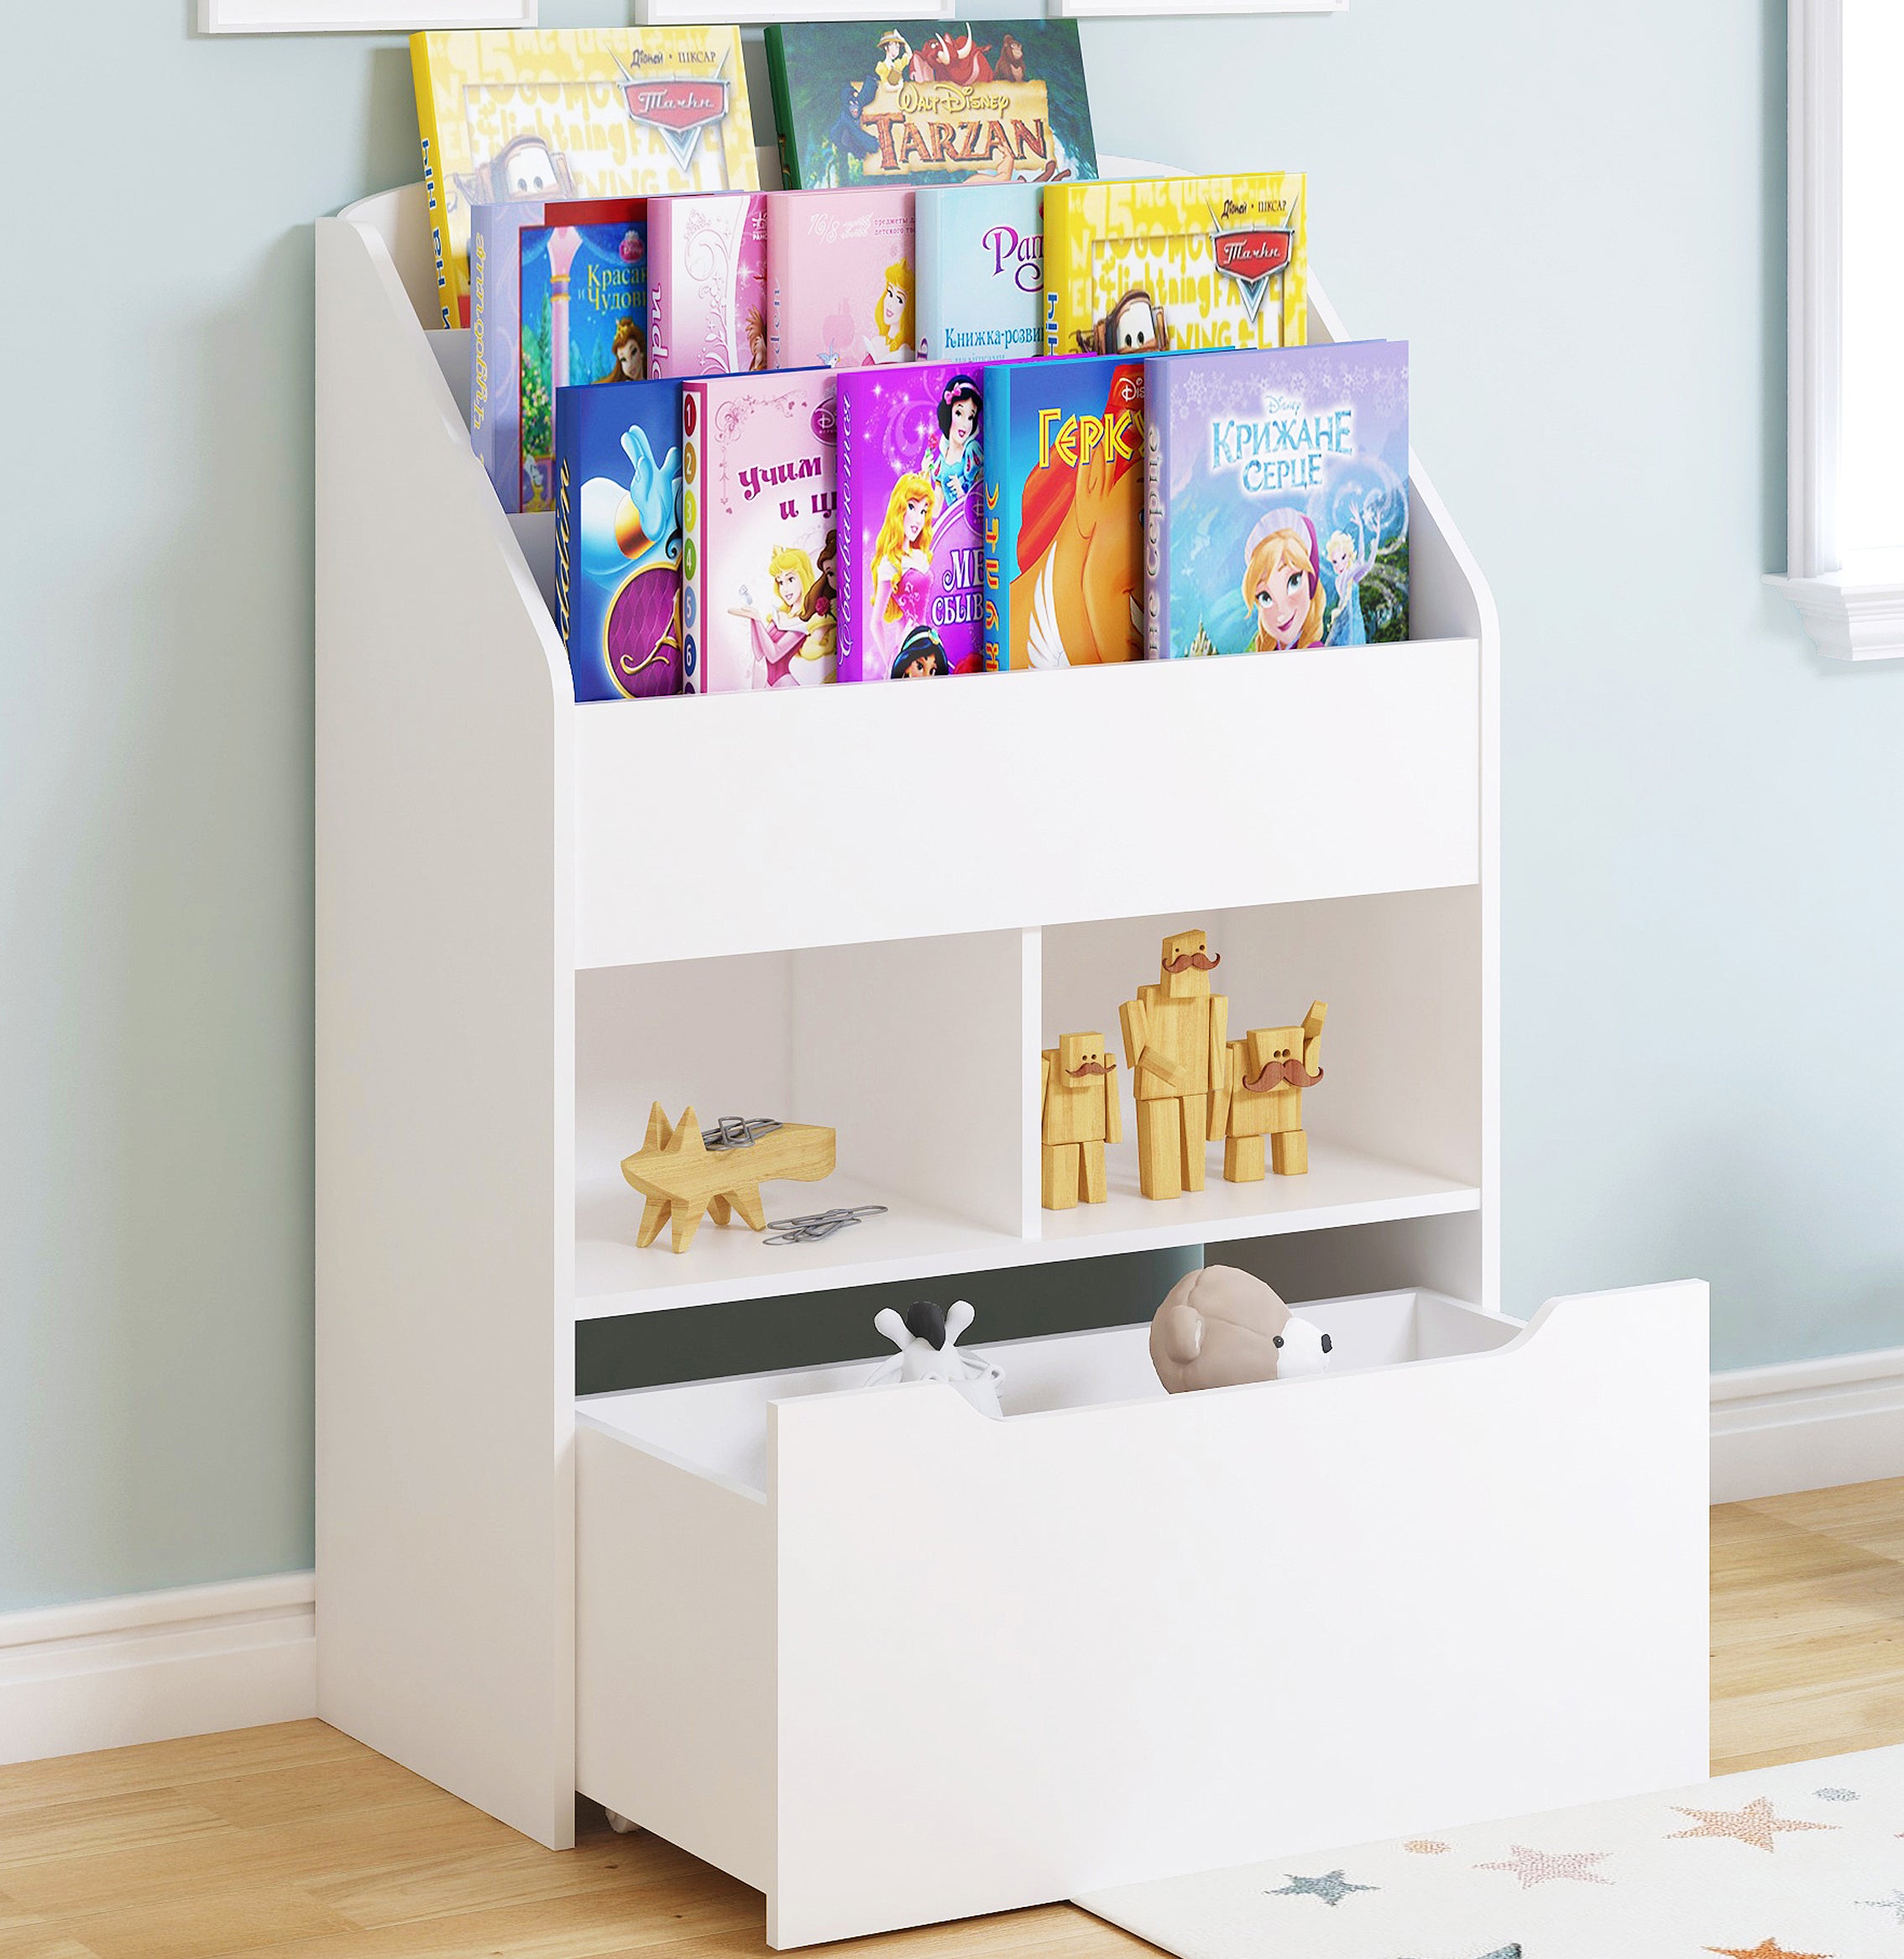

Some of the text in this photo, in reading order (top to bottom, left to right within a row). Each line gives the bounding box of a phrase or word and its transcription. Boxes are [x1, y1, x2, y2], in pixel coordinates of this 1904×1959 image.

[637, 89, 714, 114] Тачки
[861, 113, 1049, 170] TARZAN
[433, 228, 447, 289] на
[1223, 239, 1281, 265] Тачки
[1212, 411, 1353, 469] КРИЖАНЕ
[738, 457, 822, 500] Учим
[1242, 453, 1322, 493] СЕРЦЕ
[780, 500, 799, 520] и
[556, 458, 570, 653] ddin
